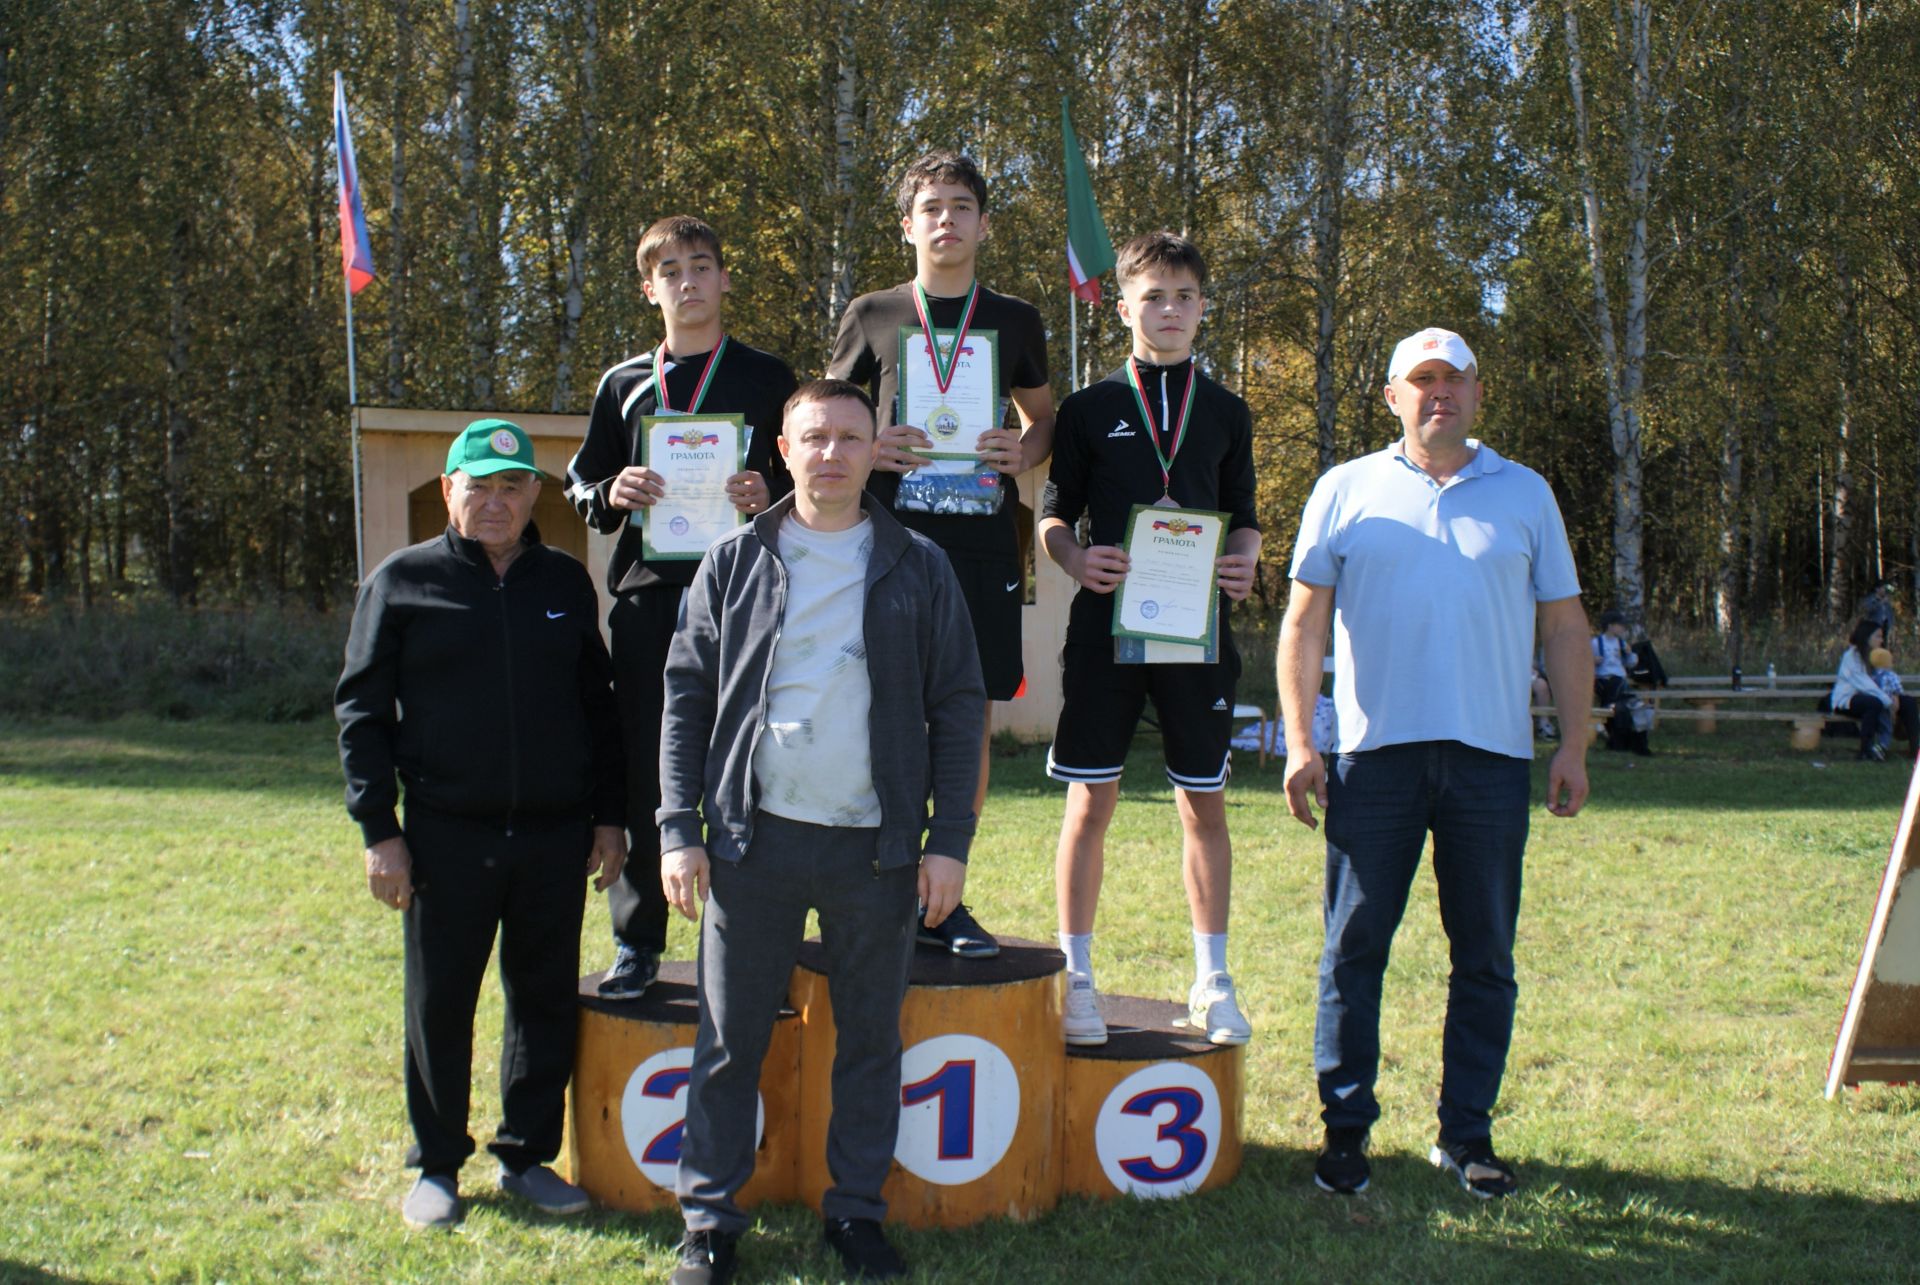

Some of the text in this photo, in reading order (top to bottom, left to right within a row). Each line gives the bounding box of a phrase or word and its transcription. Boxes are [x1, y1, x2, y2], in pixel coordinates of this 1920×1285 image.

[670, 452, 716, 460] ГРАМОТА
[1153, 536, 1196, 548] ГРАМОТА
[902, 1059, 976, 1161] 1
[1119, 1086, 1208, 1183] 3
